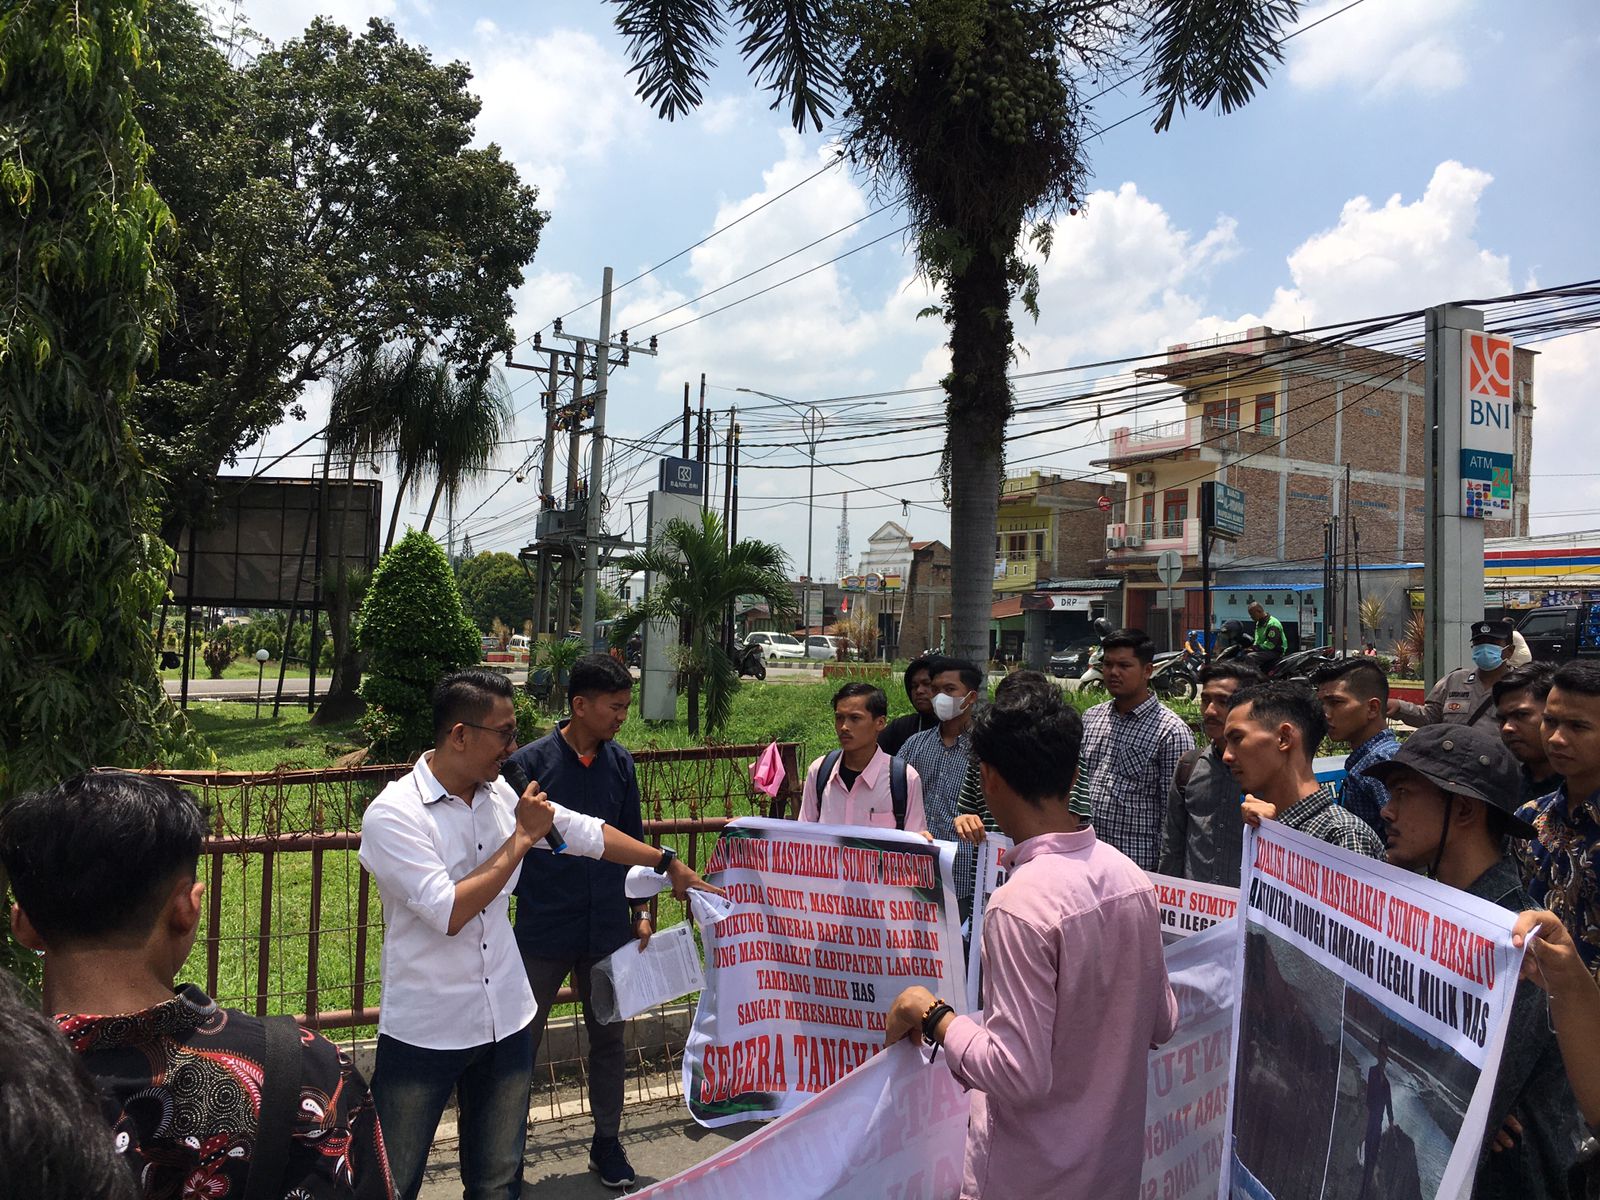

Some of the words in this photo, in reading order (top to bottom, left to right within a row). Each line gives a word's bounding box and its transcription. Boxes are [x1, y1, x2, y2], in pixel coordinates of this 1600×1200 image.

[1470, 400, 1510, 429] BNI
[1470, 455, 1493, 469] ATM
[1492, 467, 1510, 487] 24
[1061, 598, 1077, 606] DRP
[730, 838, 768, 872] ALIANSI
[772, 840, 839, 880] MASYARAKAT
[842, 846, 879, 884] SUMUT
[883, 851, 935, 889] BERSATU
[767, 886, 807, 914] SUMUT,
[810, 892, 885, 920] MASYARAKAT
[890, 900, 938, 923] SANGAT
[1189, 892, 1237, 918] SUMUT
[1254, 836, 1285, 881] KOALISI
[1286, 850, 1319, 899] ALIANSI
[1320, 865, 1386, 932] MASYARAKAT
[1387, 896, 1430, 956] SUMUT
[1431, 915, 1495, 990] BERSATU
[767, 915, 815, 940] KINERJA
[817, 921, 855, 946] BAPAK
[857, 926, 881, 949] DAN
[886, 928, 938, 951] JAJARAN
[738, 940, 811, 967] MASYARAKAT
[815, 949, 883, 975] KABUPATEN
[886, 957, 943, 979] LANGKAT
[1249, 877, 1292, 928] AKTIVITAS
[1294, 899, 1325, 949] DIDUGA
[1328, 918, 1374, 979] TAMBANG
[1377, 945, 1414, 1005] ILEGAL
[1418, 968, 1458, 1030] MILIK
[1463, 991, 1489, 1048] HAS
[757, 970, 810, 994] TAMBANG
[813, 976, 849, 999] MILIK
[851, 982, 875, 1003] HAS
[738, 999, 780, 1026] SANGAT
[784, 1001, 863, 1029] MERESAHKAN
[701, 1034, 787, 1104] SEGERA
